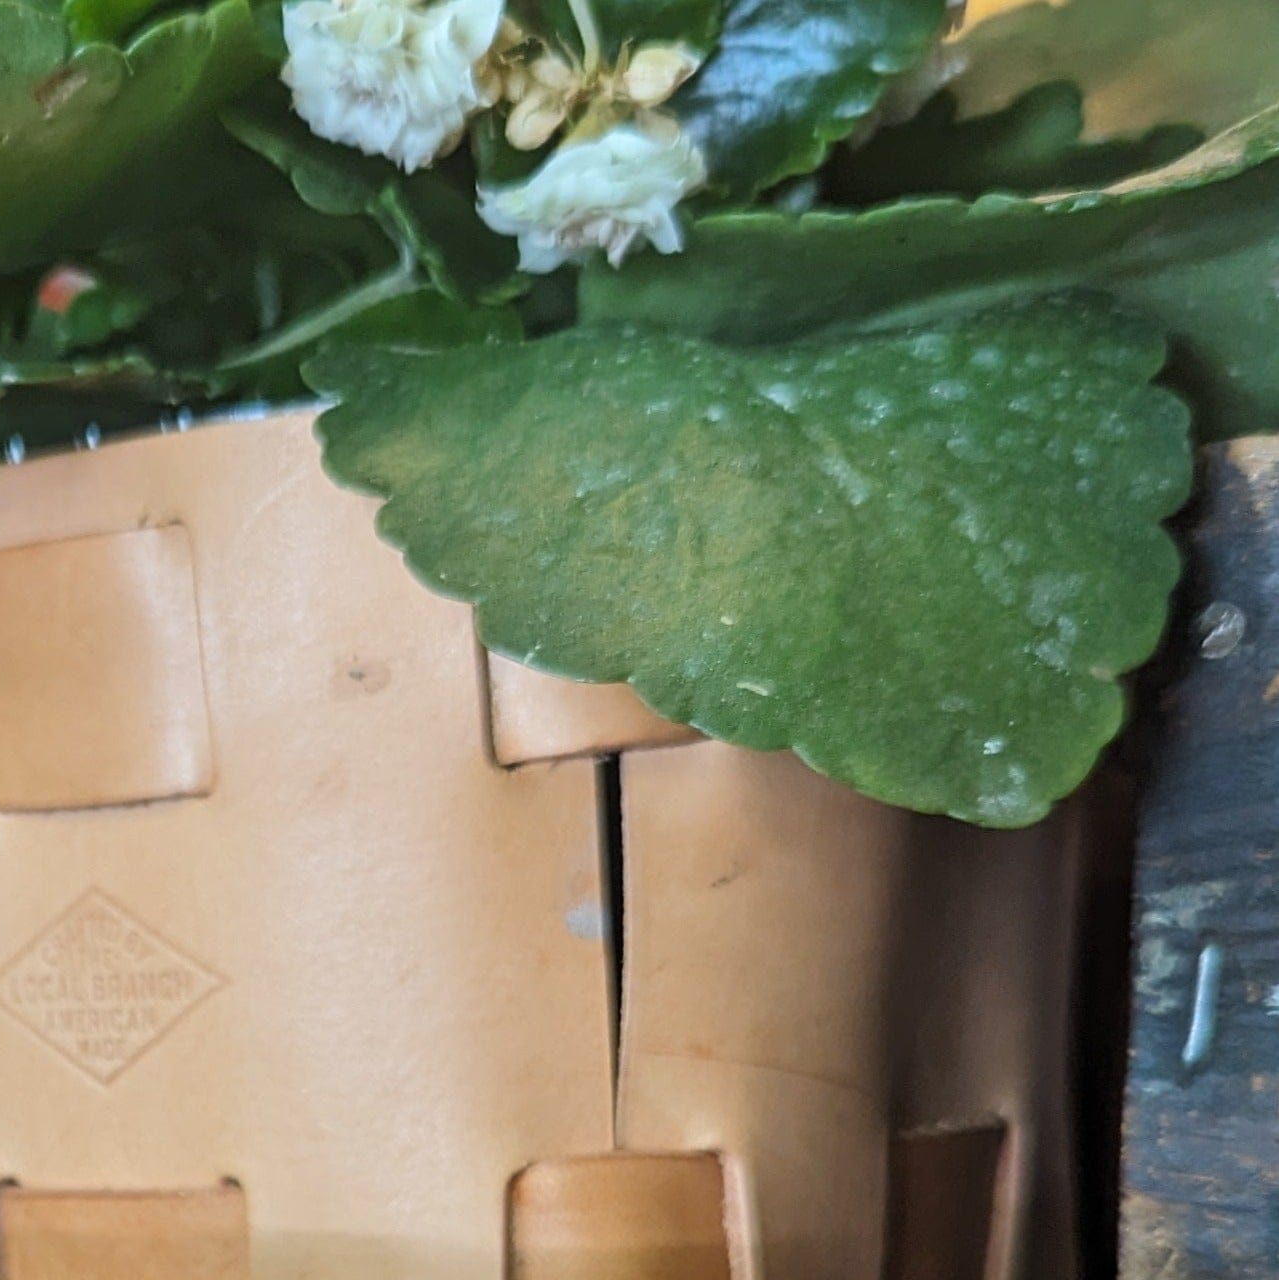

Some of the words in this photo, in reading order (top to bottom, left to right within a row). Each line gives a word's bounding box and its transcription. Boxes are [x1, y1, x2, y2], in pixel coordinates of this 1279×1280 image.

[9, 972, 87, 1004] LOCAL
[91, 968, 193, 1001] BRANCH
[44, 1006, 157, 1031] AMERICAN
